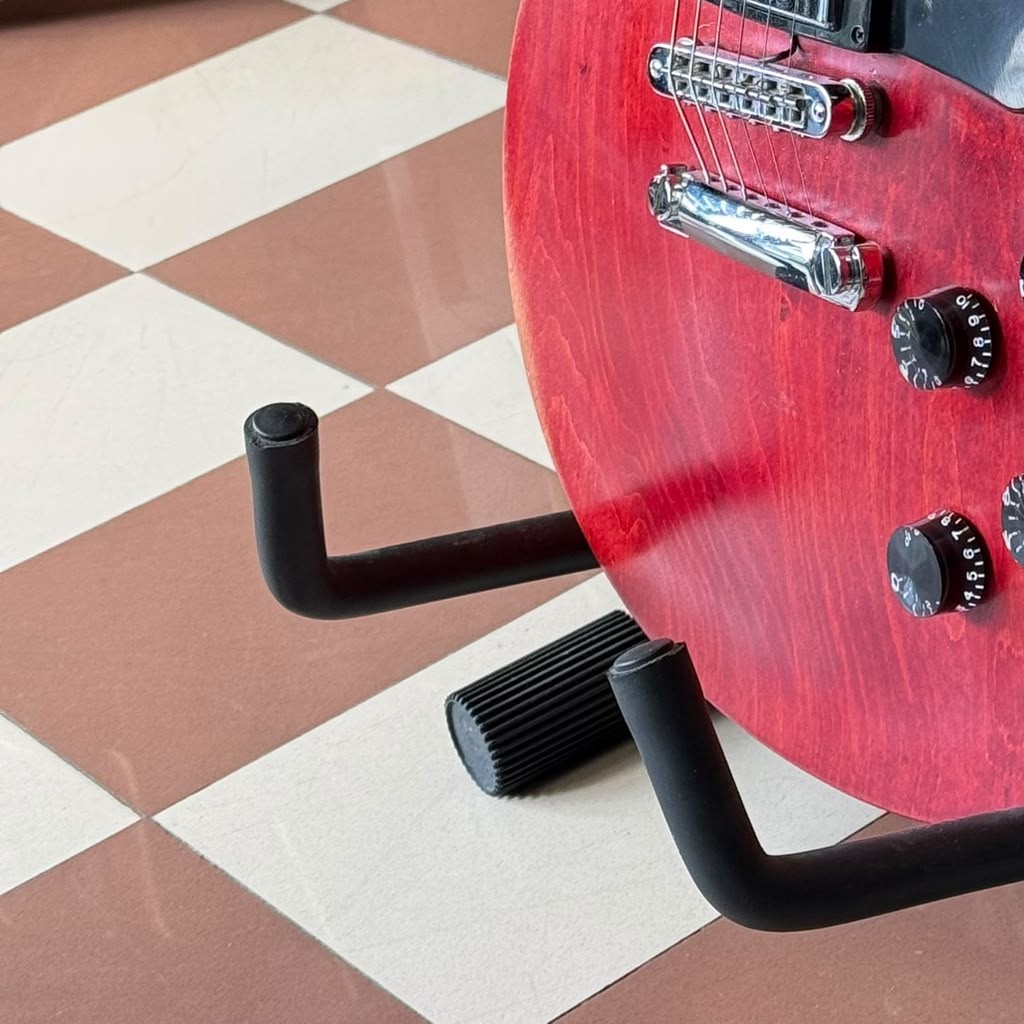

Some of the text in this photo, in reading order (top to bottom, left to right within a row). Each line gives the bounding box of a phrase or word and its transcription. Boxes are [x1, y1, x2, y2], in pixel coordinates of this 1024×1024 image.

[973, 337, 984, 348] 8
[970, 357, 983, 367] 7
[951, 529, 963, 541] 7
[963, 548, 975, 559] 6
[966, 571, 978, 581] 5
[964, 590, 974, 600] 4
